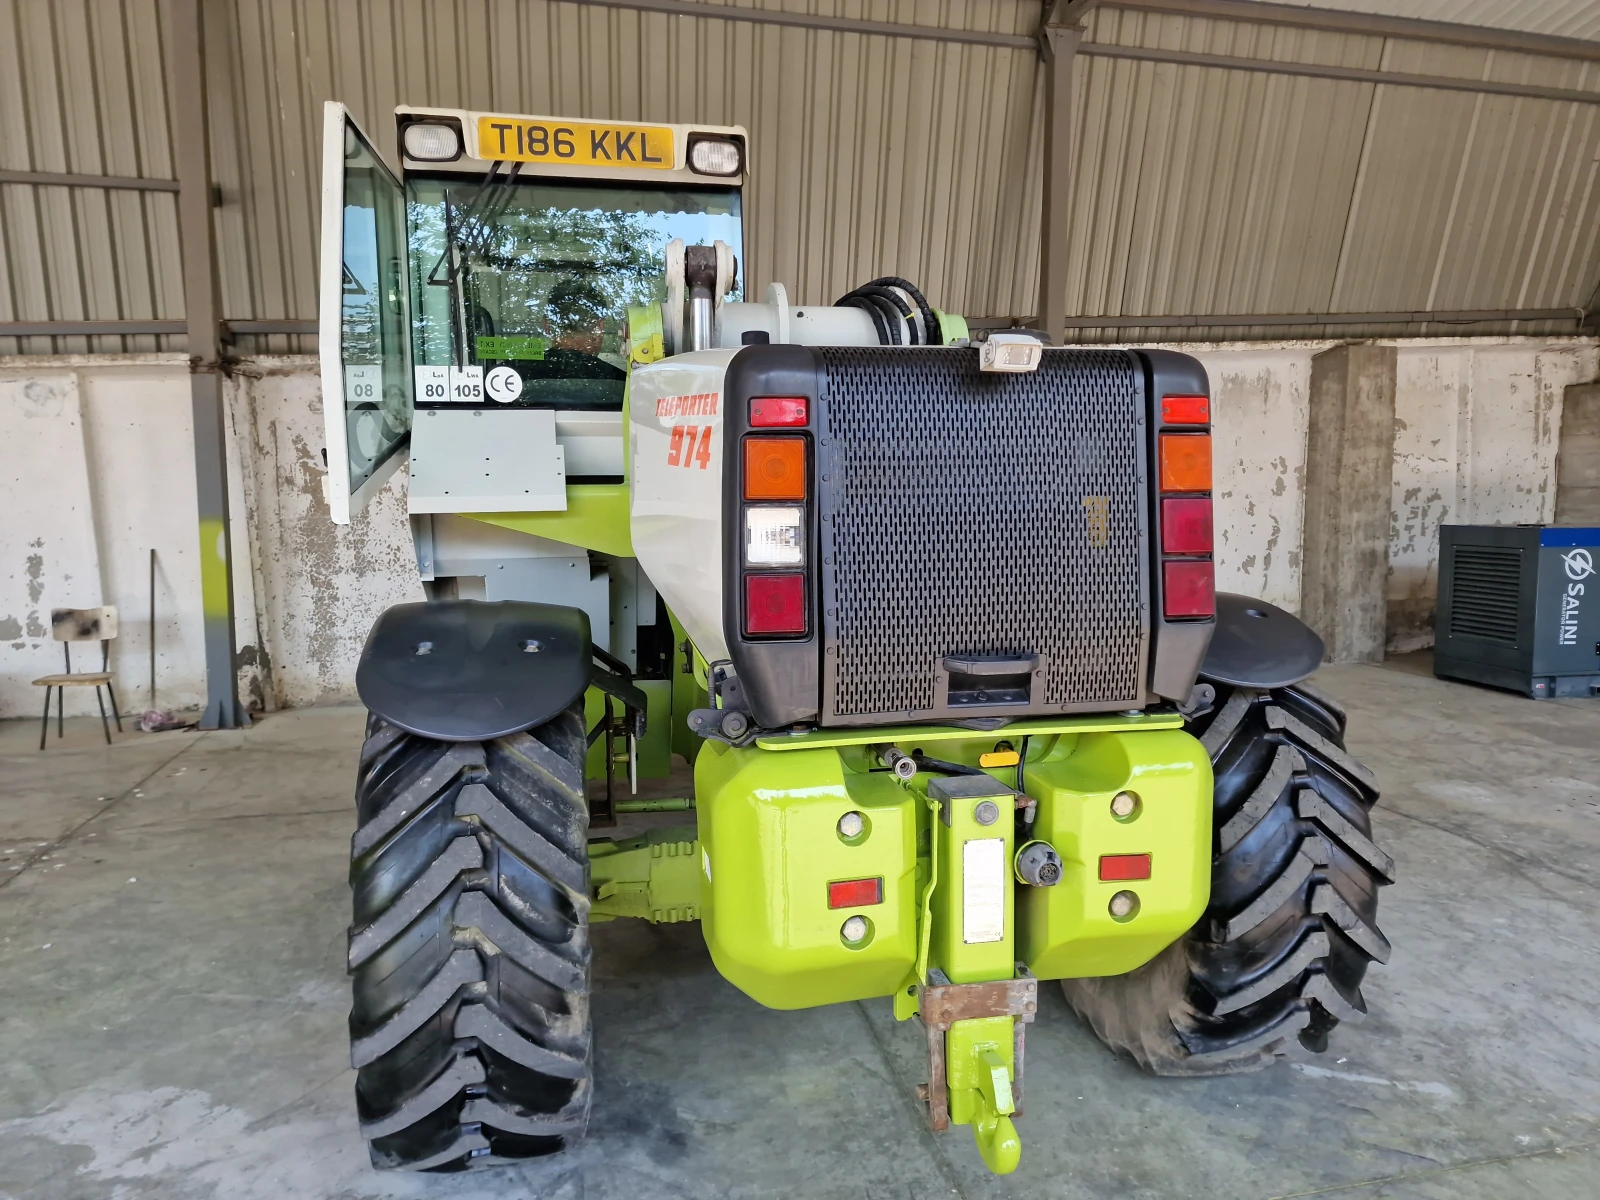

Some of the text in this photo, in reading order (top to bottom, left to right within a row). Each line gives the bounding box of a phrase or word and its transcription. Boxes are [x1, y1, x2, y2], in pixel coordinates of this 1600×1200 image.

[490, 123, 662, 163] T186 KKL
[425, 384, 445, 398] 80
[454, 384, 481, 398] 105
[655, 392, 719, 417] TELEPORTER
[667, 425, 713, 470] 974
[1563, 583, 1585, 645] SALINI
